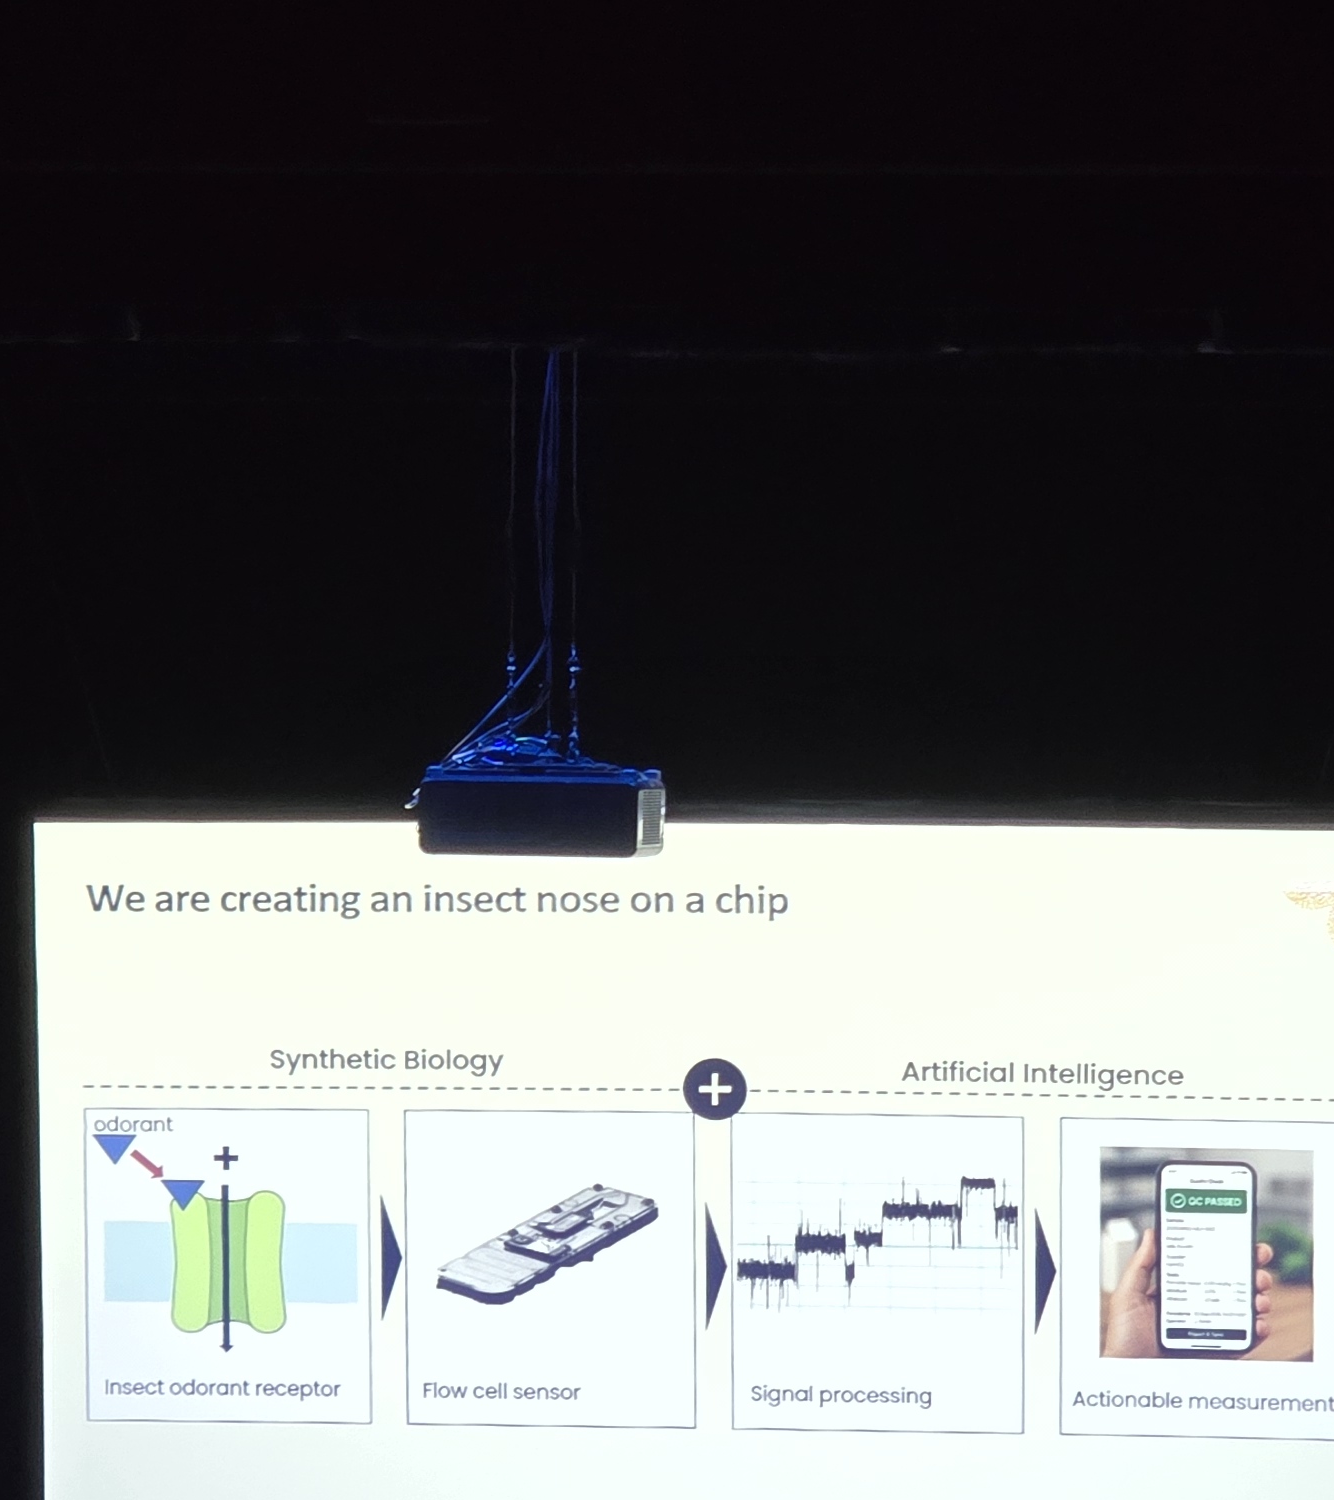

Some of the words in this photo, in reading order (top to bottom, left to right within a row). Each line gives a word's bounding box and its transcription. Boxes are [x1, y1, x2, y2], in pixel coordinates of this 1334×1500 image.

[86, 884, 146, 913] We
[155, 890, 210, 913] are
[220, 884, 360, 919] creating
[370, 890, 412, 913] an
[424, 884, 526, 913] insect
[537, 891, 620, 914] nose
[630, 891, 676, 914] on
[686, 891, 705, 914] a
[716, 884, 789, 921] chip
[269, 1048, 396, 1075] Synthetic
[404, 1049, 504, 1077] Biology
[902, 1060, 1015, 1083] Artificial
[1023, 1062, 1185, 1091] Intelligence
[93, 1115, 174, 1132] odorant
[1205, 1197, 1242, 1207] PASSED
[105, 1378, 165, 1397] Insect
[169, 1379, 250, 1397] odorant
[255, 1380, 341, 1401] receptor
[423, 1382, 467, 1401] Flow
[473, 1383, 508, 1401] cell
[513, 1386, 581, 1402] sensor
[750, 1384, 814, 1407] Signal
[820, 1386, 932, 1409] processing
[1072, 1391, 1183, 1410] Actionable
